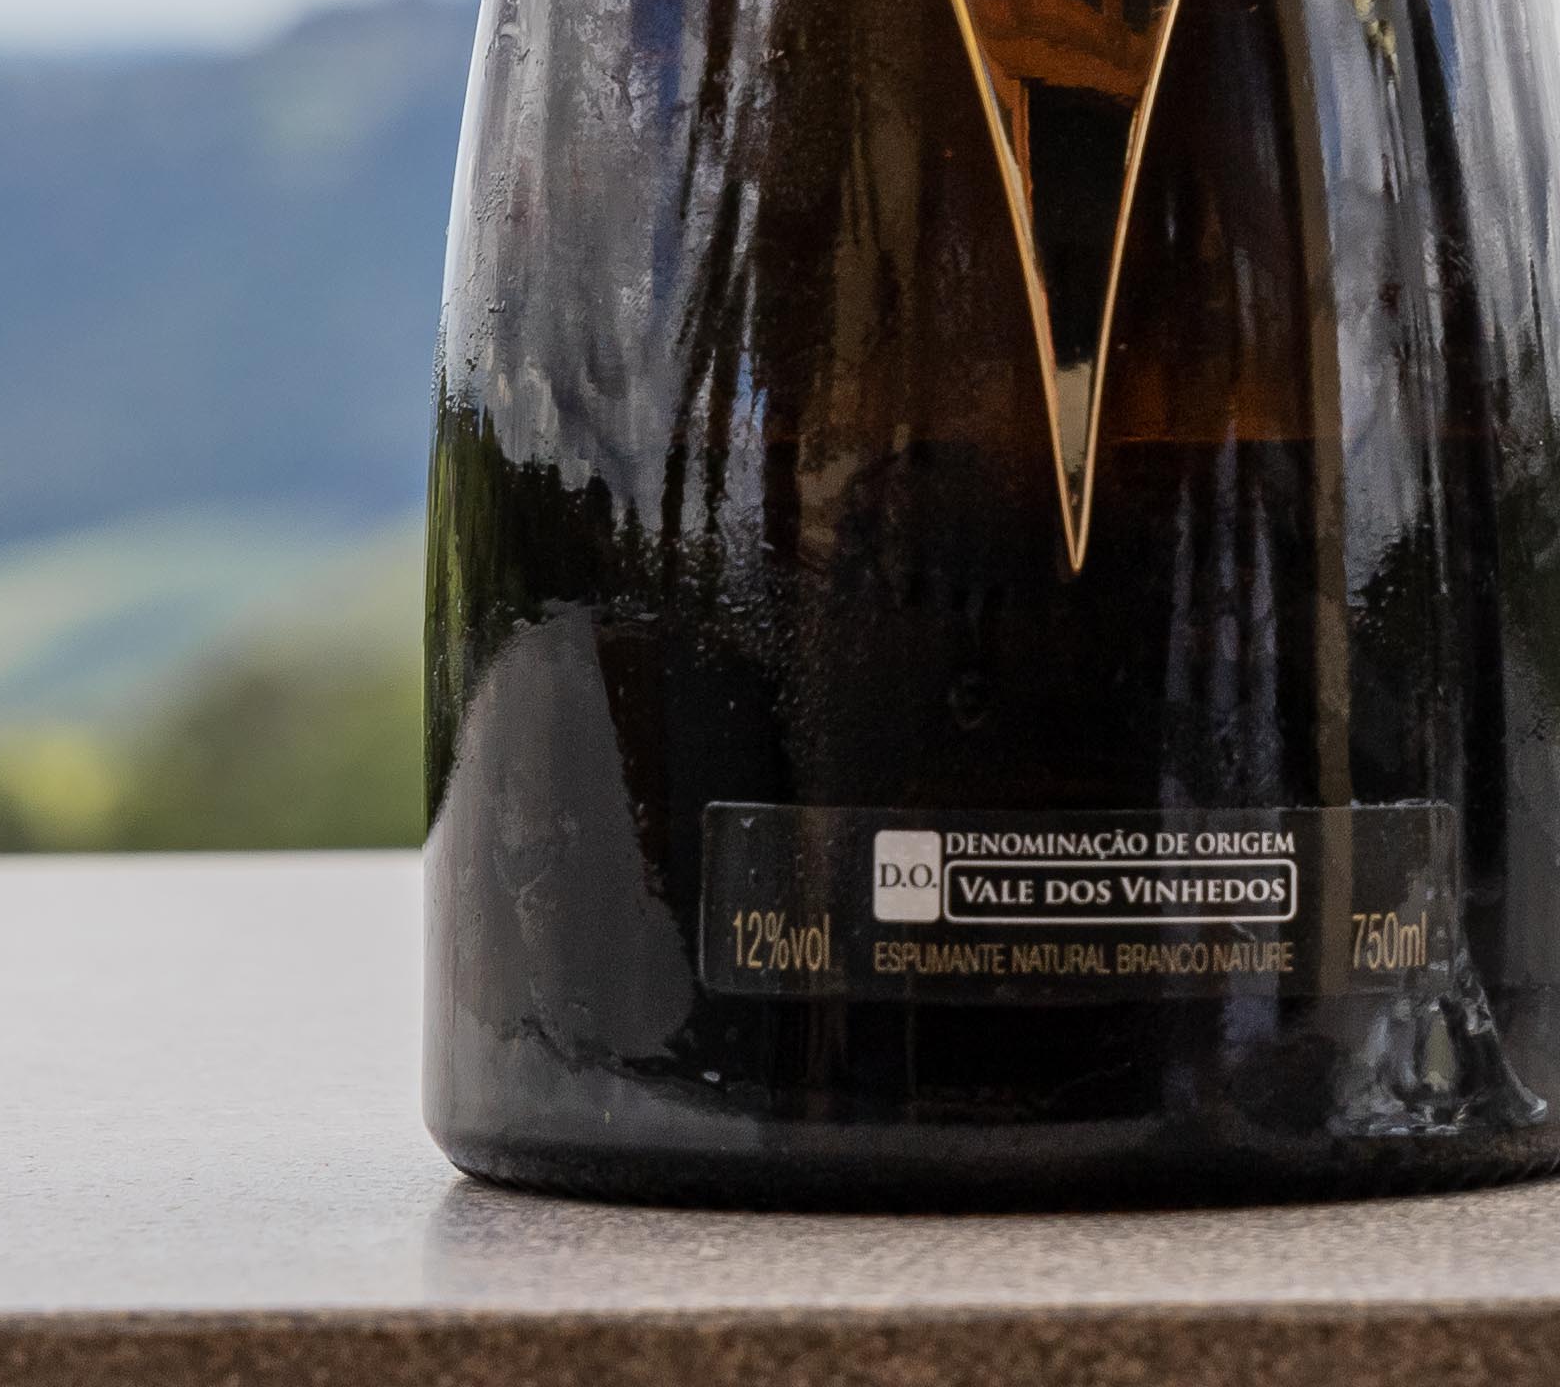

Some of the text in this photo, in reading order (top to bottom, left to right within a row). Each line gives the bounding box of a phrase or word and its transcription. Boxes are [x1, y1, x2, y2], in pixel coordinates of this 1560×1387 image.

[945, 829, 1296, 859] DENOMINAÇÃO DE ORIGEM
[877, 862, 938, 889] D.O.
[959, 876, 1287, 904] VALE DOS VINHEDOS
[732, 909, 831, 971] 12%vol
[1351, 910, 1428, 971] 750ml
[873, 940, 1295, 974] ESPUMANTE NATURAL BRANCO NATURE
